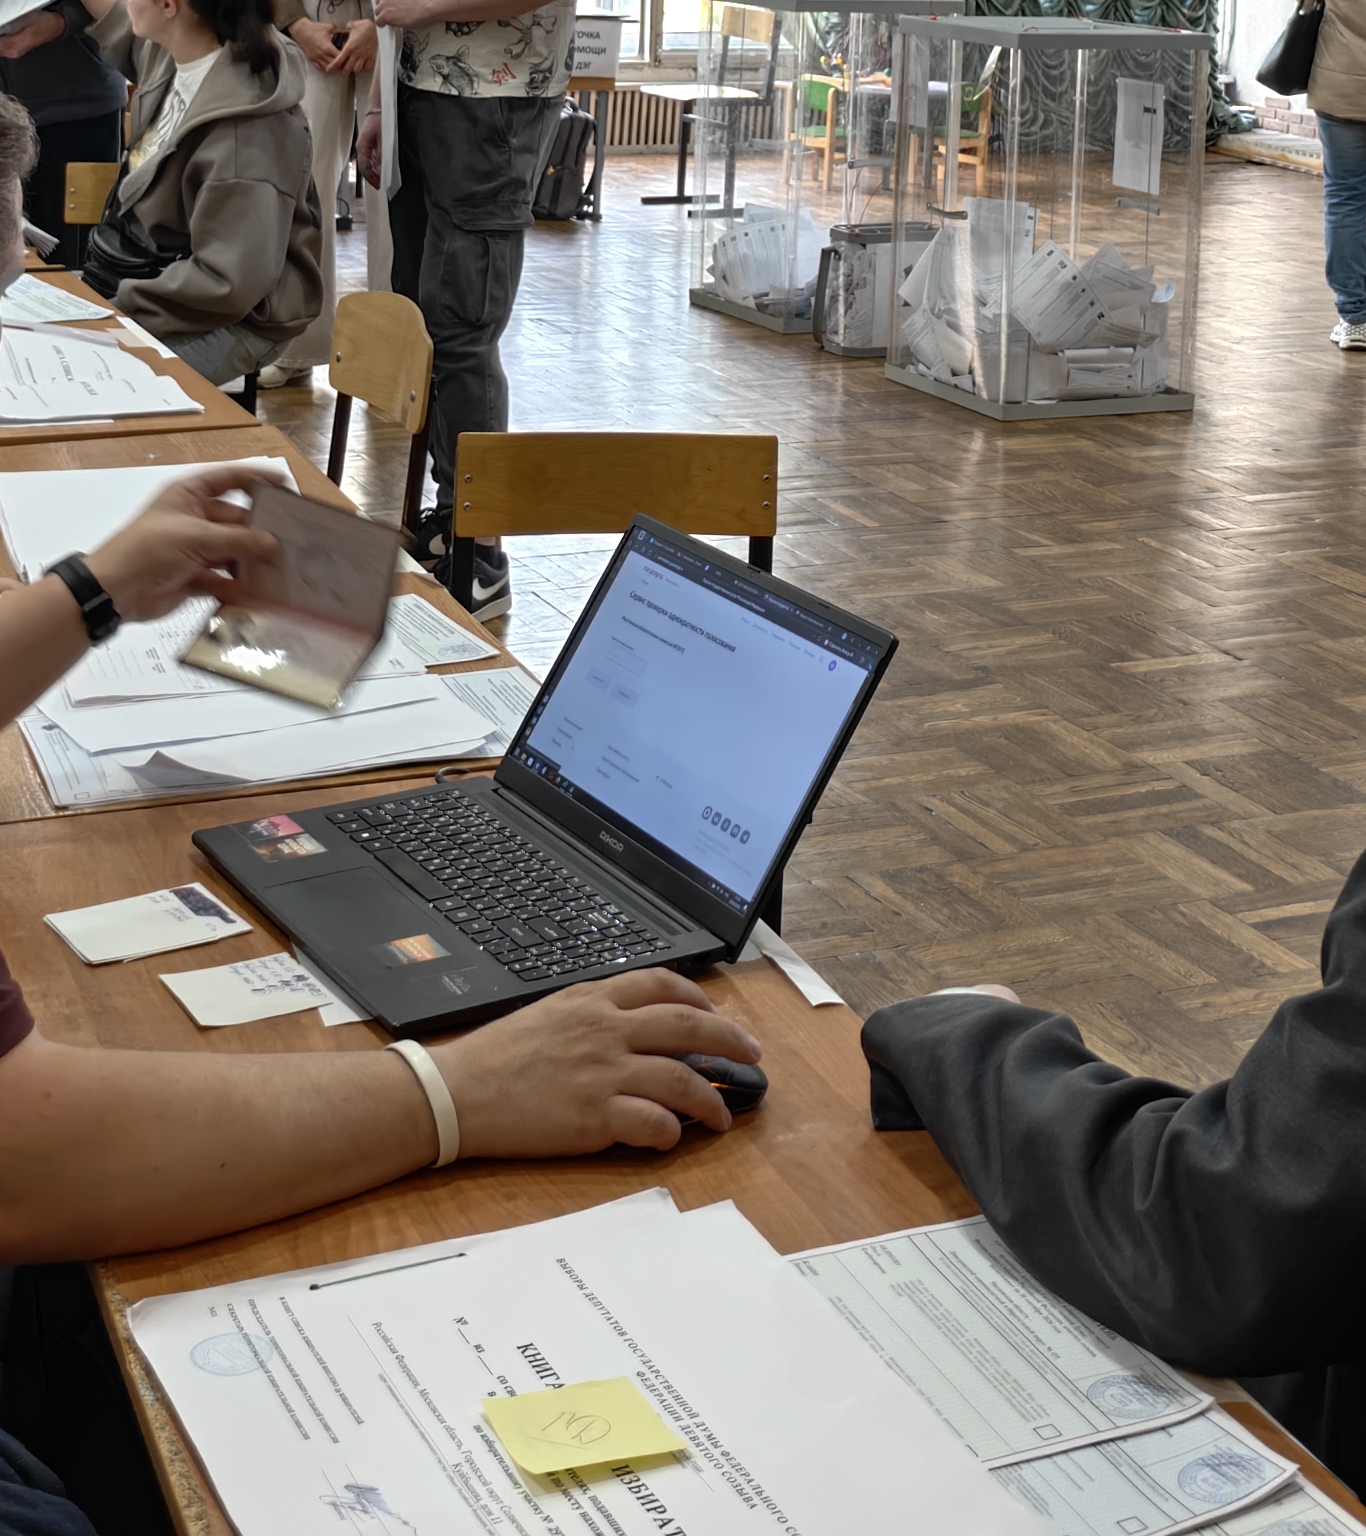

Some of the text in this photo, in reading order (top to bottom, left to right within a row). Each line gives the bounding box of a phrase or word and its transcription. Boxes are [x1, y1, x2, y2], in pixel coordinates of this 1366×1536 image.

[576, 30, 601, 40] ОЧКА
[513, 1342, 568, 1391] КНИГА
[553, 1257, 791, 1524] ВЫБОРЫ ДЕПУТАТОВ ГОСУДАРСТВЕННОЙ ДУМЫ ФЕДЕРАЛЬНОГО
[632, 1370, 760, 1509] ФЕДЕРАЦИИ ДЕВЯТОГО СОЗЫВА
